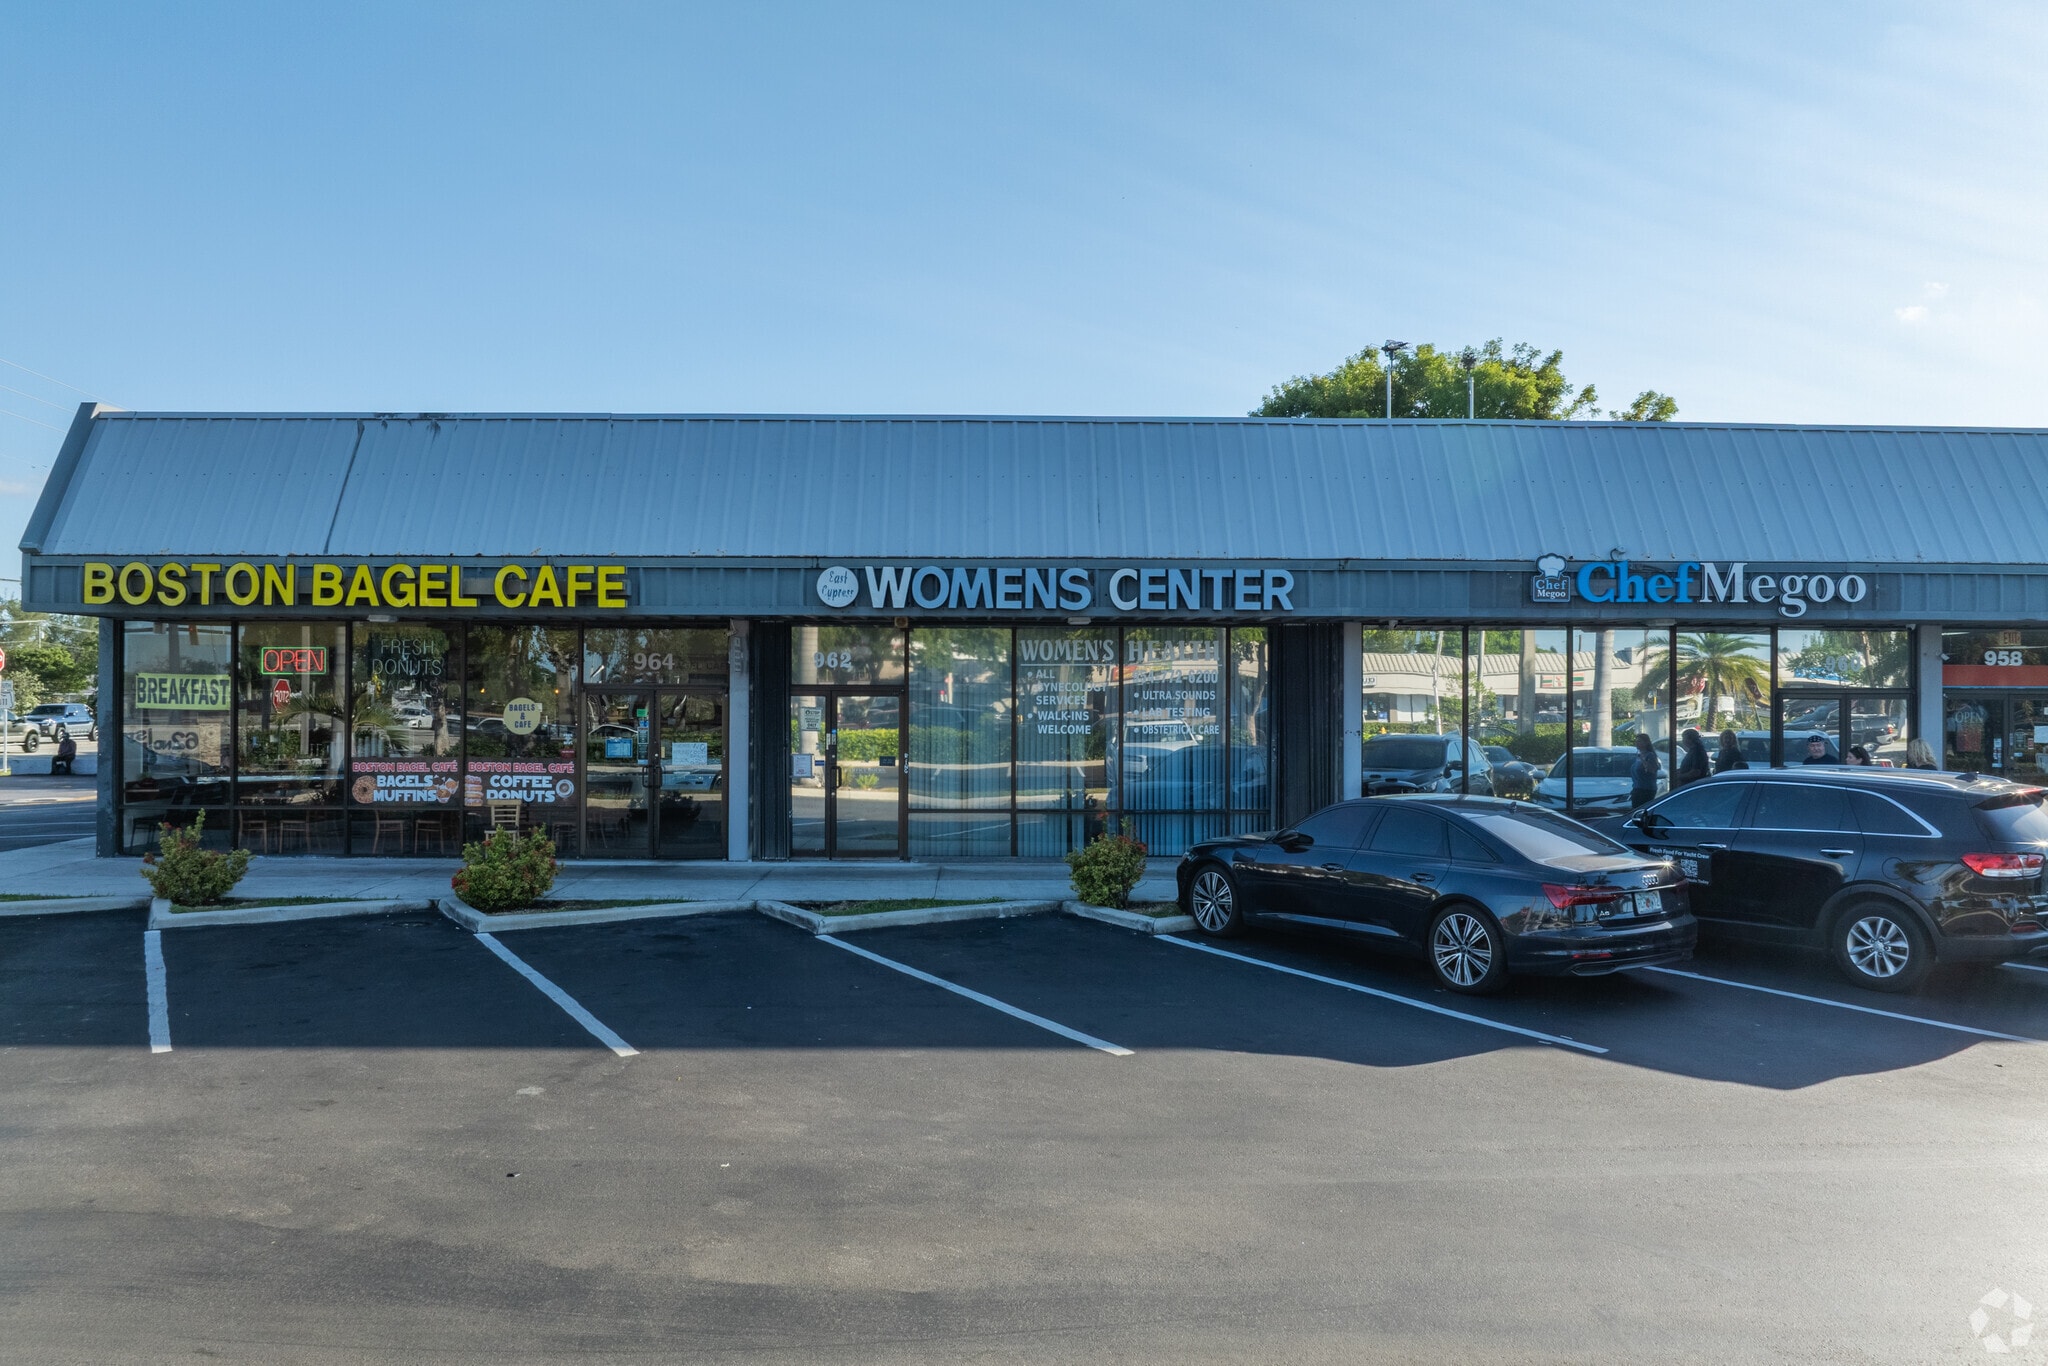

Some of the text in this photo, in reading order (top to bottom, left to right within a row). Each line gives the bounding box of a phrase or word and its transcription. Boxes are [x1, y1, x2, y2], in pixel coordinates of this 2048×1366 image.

[829, 570, 848, 584] East
[83, 561, 628, 609] BOSTON BAGEL CAFE
[864, 565, 1295, 611] WOMENS CENTER
[1535, 579, 1568, 590] Chef
[821, 584, 854, 601] Cypress
[1537, 589, 1567, 600] Megoo
[380, 638, 435, 656] FRESH
[1020, 639, 1220, 661] WOMEN'S HEALTH
[263, 649, 325, 672] OPEN
[633, 652, 675, 671] 964
[813, 651, 852, 668] 962
[1824, 655, 1862, 672] 960
[1984, 650, 2023, 666] 958
[372, 658, 442, 676] DONUTS
[1036, 669, 1056, 679] ALL
[136, 676, 230, 706] BREAKFAST
[1142, 690, 1216, 701] ULTRA SOUNDS
[508, 703, 536, 712] BAGELS
[1035, 695, 1087, 706] SERVICES
[520, 712, 526, 720] &
[1037, 710, 1090, 721] WALK-INS
[1142, 707, 1211, 718] LAB TESTING
[1955, 710, 1983, 724] OPEN
[514, 720, 533, 729] CAFE
[1037, 724, 1092, 735] WELCOME
[1141, 724, 1220, 735] OBSTETRICAL CARE
[352, 759, 459, 773] BOSTON BAGEL CAFÉ
[468, 760, 575, 774] BOSTON BAGEL CAFÉ
[376, 774, 434, 788] BAGELS
[489, 774, 553, 788] COFFEE
[373, 789, 438, 802] MUFFINS
[486, 789, 556, 803] DONUTS
